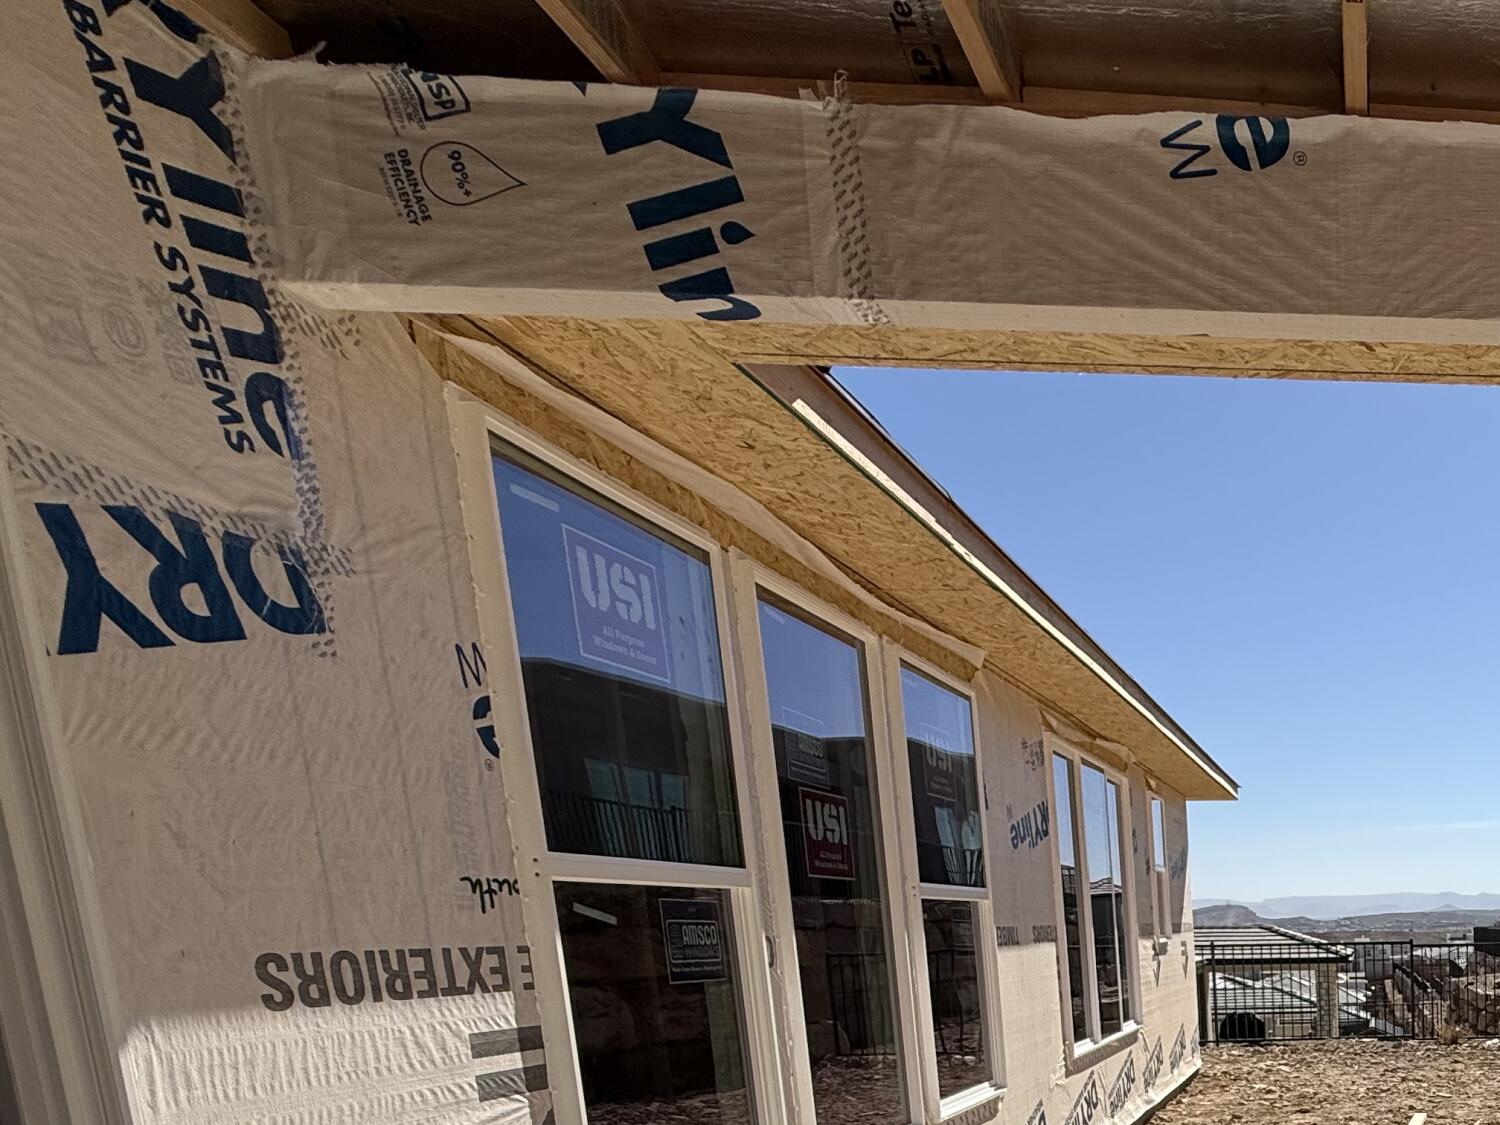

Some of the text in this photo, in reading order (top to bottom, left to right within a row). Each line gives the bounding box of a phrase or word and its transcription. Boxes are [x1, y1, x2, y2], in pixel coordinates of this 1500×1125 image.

[384, 152, 421, 226] EFFICIENCY
[397, 148, 432, 222] DRAINAGE
[448, 150, 472, 198] 90%+
[63, 0, 171, 229] BARRIER
[154, 241, 255, 454] SYSTEMS
[575, 545, 656, 630] USI
[806, 798, 848, 845] USI
[682, 924, 718, 946] AMSCO
[254, 946, 511, 1011] EXTERIORS
